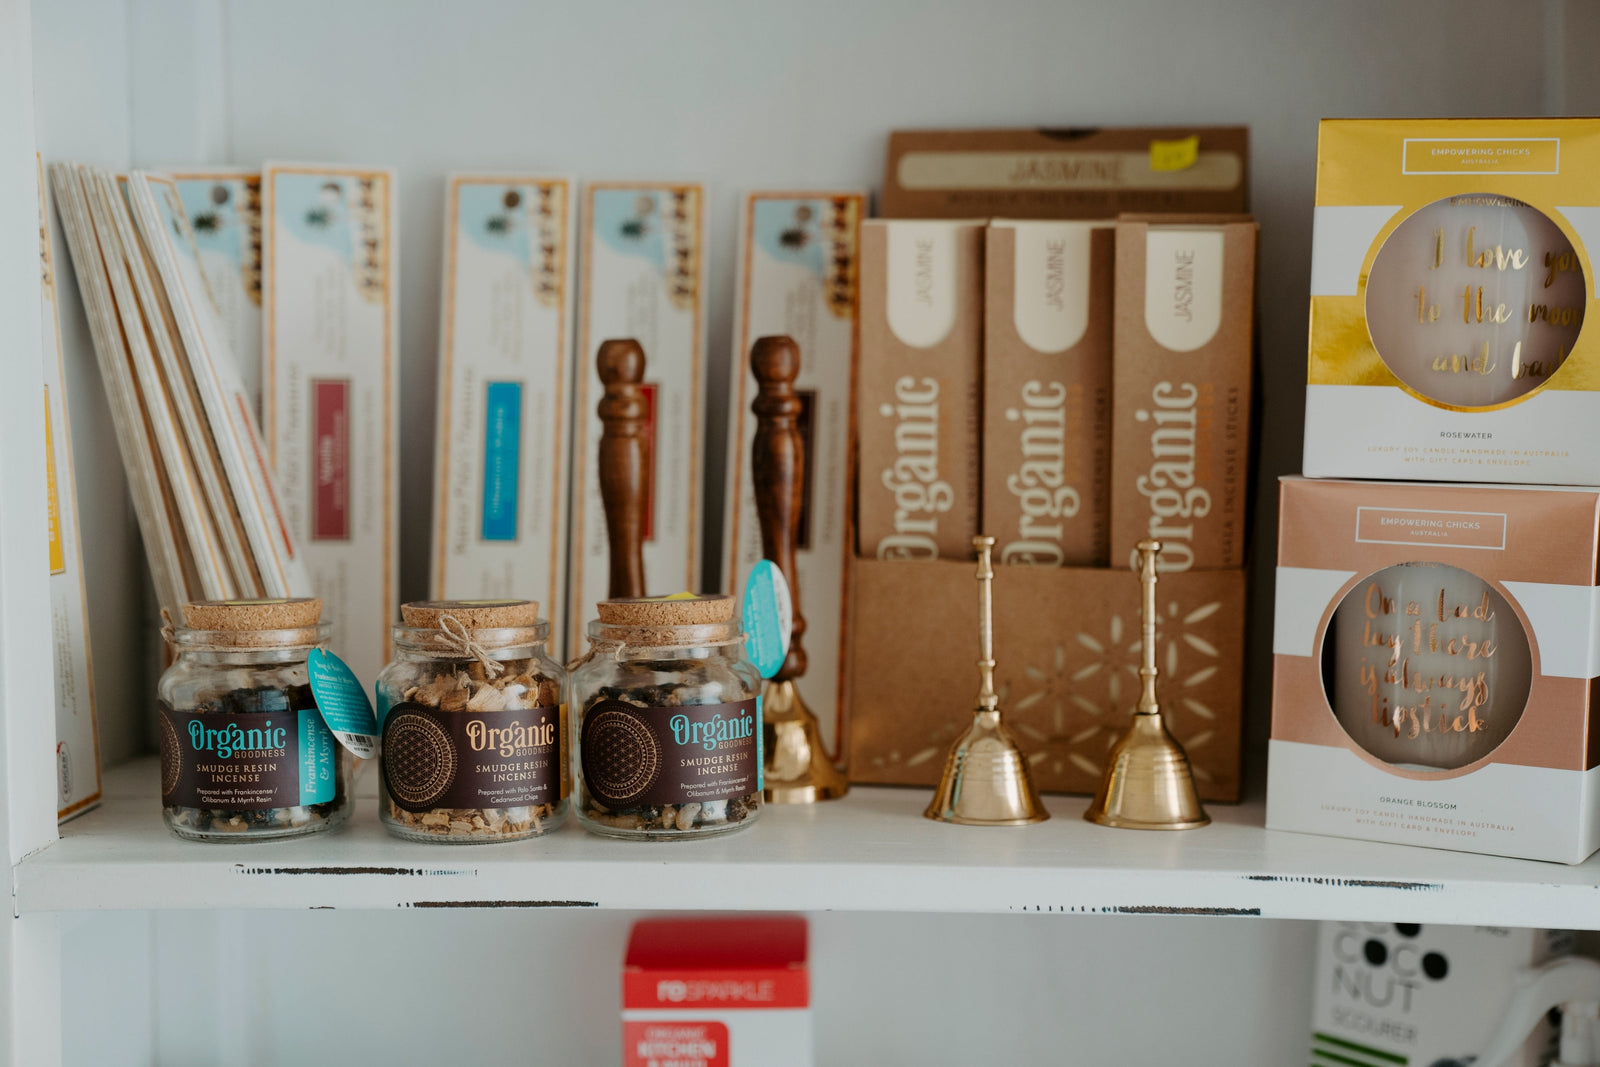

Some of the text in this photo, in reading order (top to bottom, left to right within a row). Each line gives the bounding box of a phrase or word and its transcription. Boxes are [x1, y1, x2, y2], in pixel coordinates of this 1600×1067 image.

[1431, 148, 1530, 156] EMPOWERING CHICKS
[1466, 226, 1529, 271] love
[1046, 238, 1066, 312] JASMINE
[1174, 249, 1194, 322] JASMINE
[1413, 285, 1442, 324] to
[1459, 285, 1513, 324] the
[1432, 341, 1496, 375] and
[1440, 431, 1493, 440] ROSEWATER
[1523, 450, 1570, 458] AUSTRALIA
[1380, 517, 1480, 530] EMPOWERING CHICKS
[1365, 582, 1396, 619] On
[1407, 601, 1421, 616] a
[1384, 658, 1489, 711] always
[1373, 694, 1489, 740] lipstick
[465, 716, 554, 758] Organic
[669, 709, 753, 751] Organic
[188, 719, 287, 759] Organic
[718, 737, 752, 750] GOODNESS
[234, 749, 286, 759] GOODNESS
[305, 718, 316, 793] Frankincense
[319, 728, 331, 780] & Myrrh
[516, 745, 553, 757] GOODNESS
[475, 759, 548, 773] SMUDGE RESIN
[680, 752, 748, 767] SMUDGE RESIN
[196, 763, 277, 773] SMUDGE RESIN
[697, 763, 738, 776] INCENSE
[211, 774, 260, 783] INCENSE
[493, 771, 537, 782] INCENSE
[680, 782, 706, 790] Prepared
[718, 777, 746, 786] Frankincense
[196, 787, 220, 796] Prepared
[234, 788, 273, 796] Frankincense
[477, 788, 504, 797] Prepared
[686, 790, 714, 798] Olibanum
[201, 796, 230, 804] Olibanum
[237, 797, 255, 805] Myrrh
[490, 796, 524, 804] Cedarwood
[1379, 796, 1457, 810] ORANGE BLOSSOM
[1379, 821, 1397, 829] GIFT
[1401, 823, 1422, 832] CARD
[1434, 826, 1477, 837] ENVELOPE
[1408, 814, 1453, 826] HANDMADE
[1470, 821, 1515, 832] AUSTRALIA
[1332, 964, 1423, 1014] NUT
